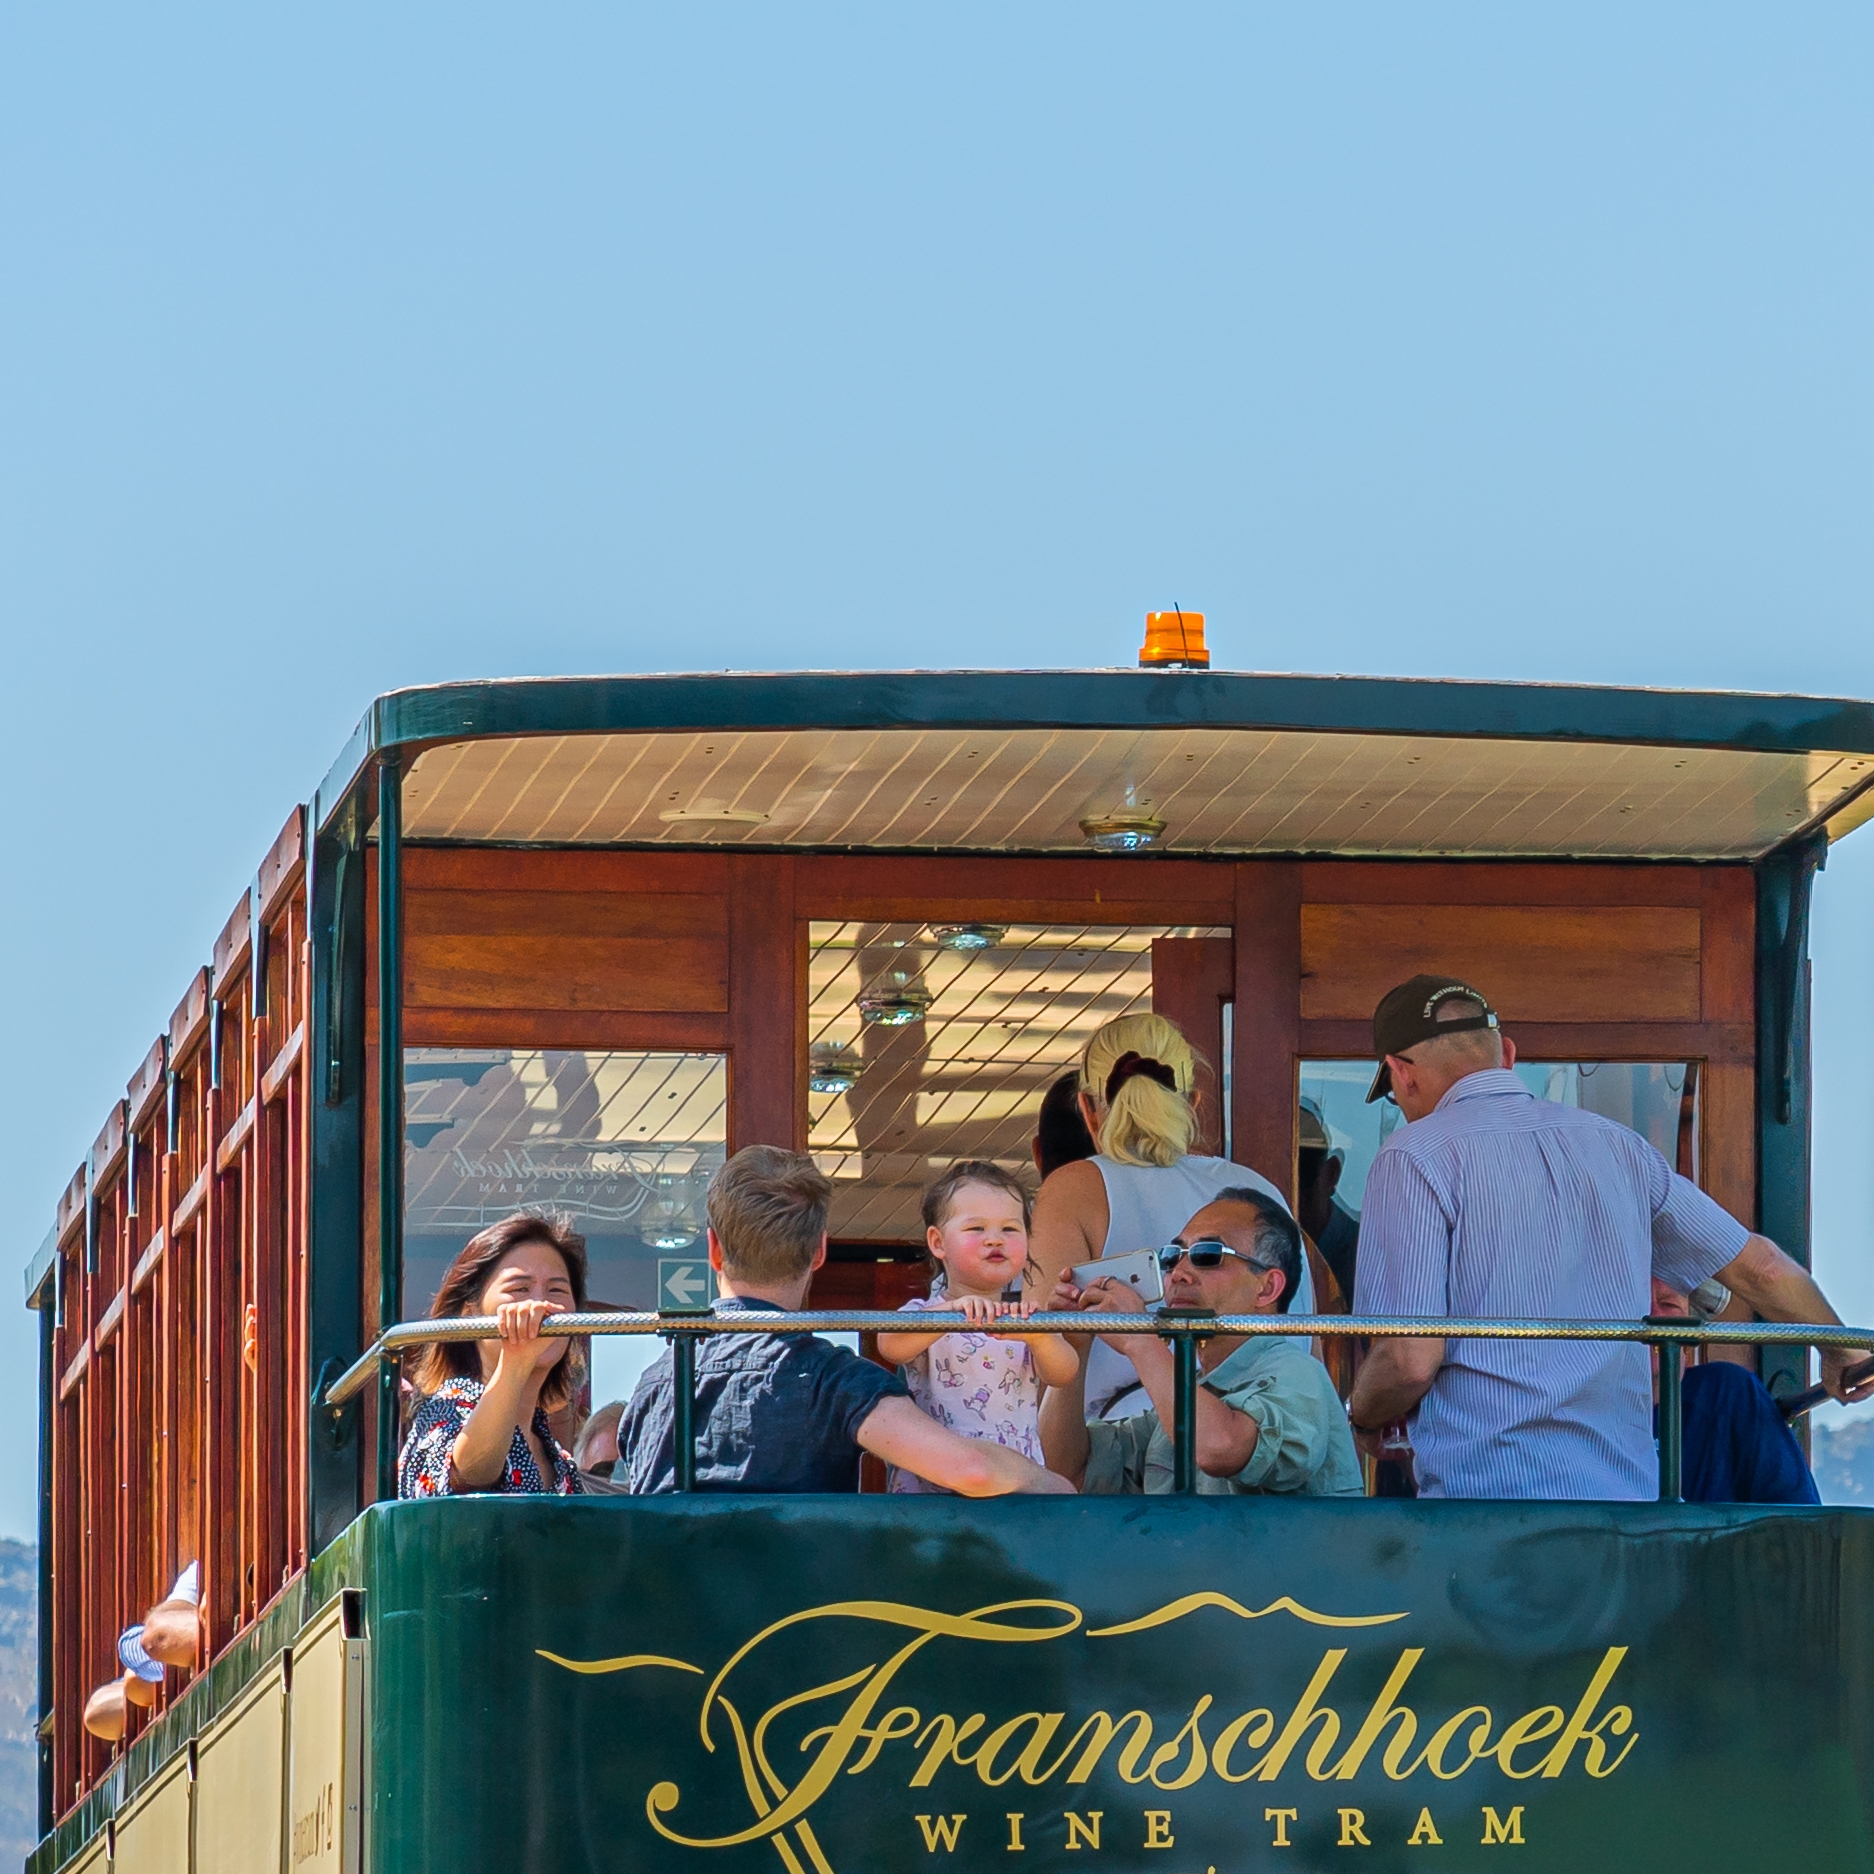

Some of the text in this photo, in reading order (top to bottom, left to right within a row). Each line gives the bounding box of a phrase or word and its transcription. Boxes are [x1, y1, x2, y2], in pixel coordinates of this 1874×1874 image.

[647, 1599, 1638, 1847] Franschhoek
[916, 1806, 1527, 1852] WINE TRAM
